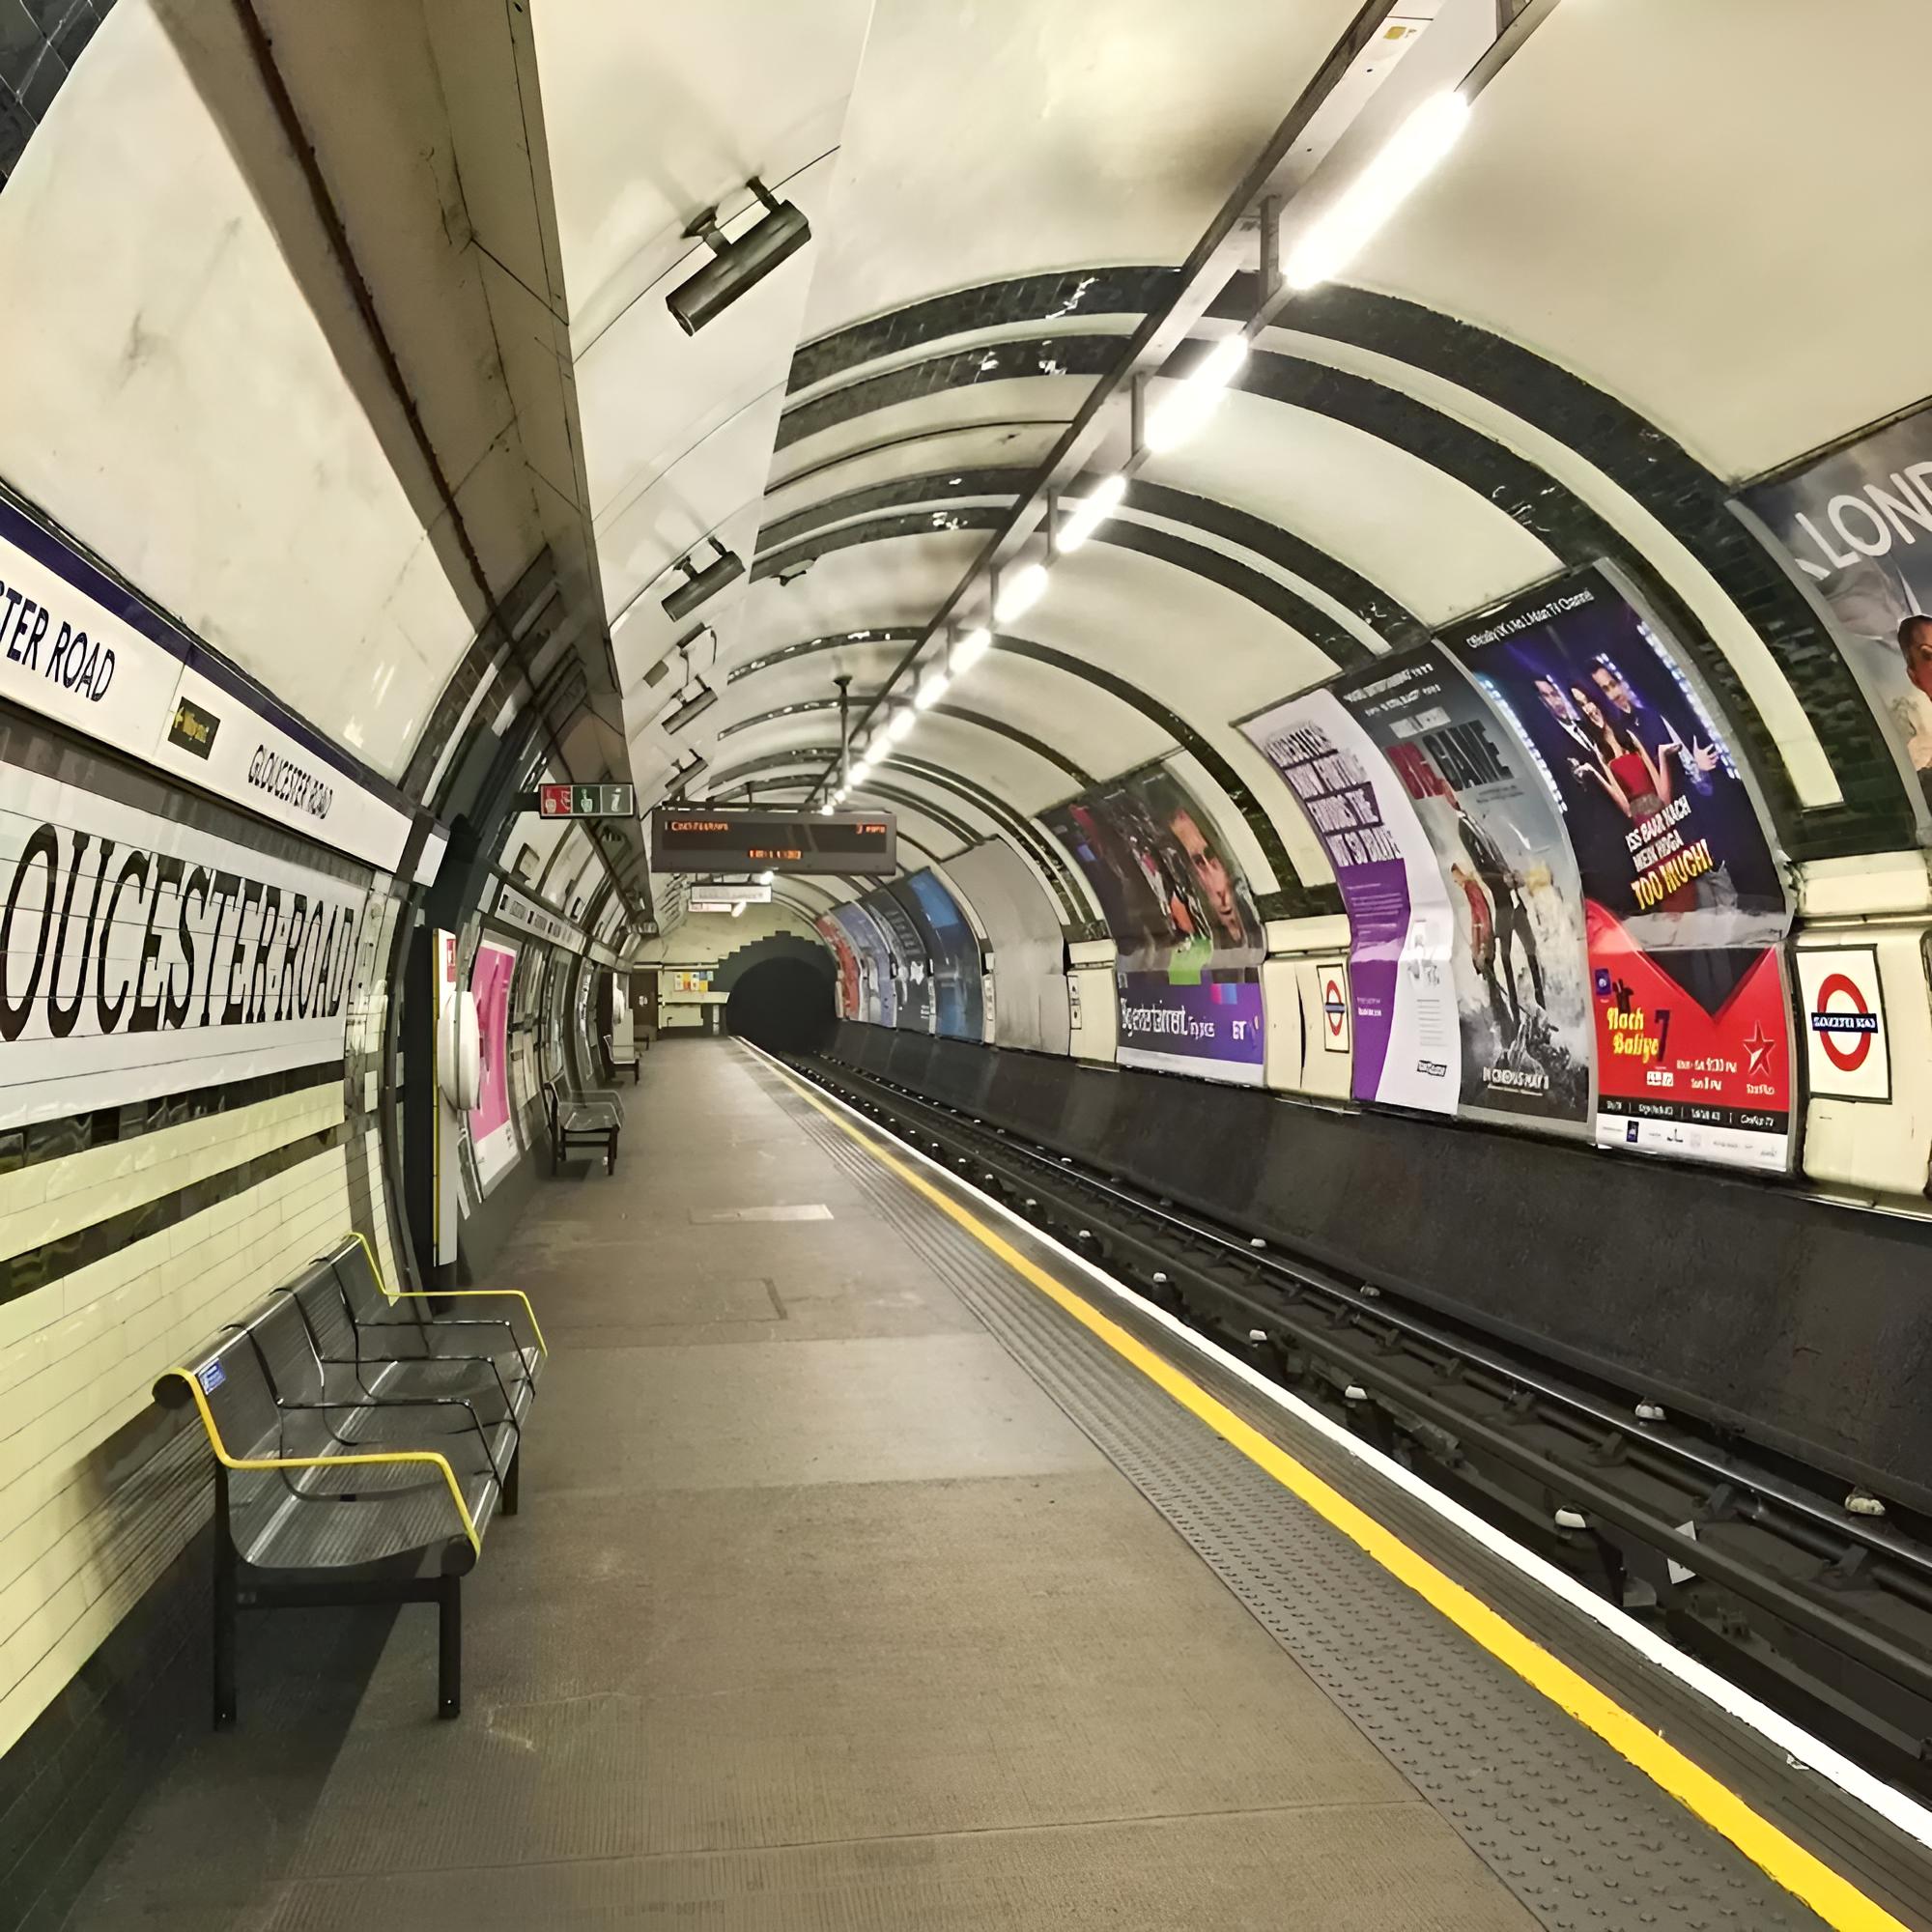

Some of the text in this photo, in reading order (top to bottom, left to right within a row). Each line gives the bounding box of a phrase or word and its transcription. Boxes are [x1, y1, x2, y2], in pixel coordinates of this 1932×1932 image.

[45, 621, 115, 702] ROAD
[1631, 838, 1714, 910] TOO MUCH!
